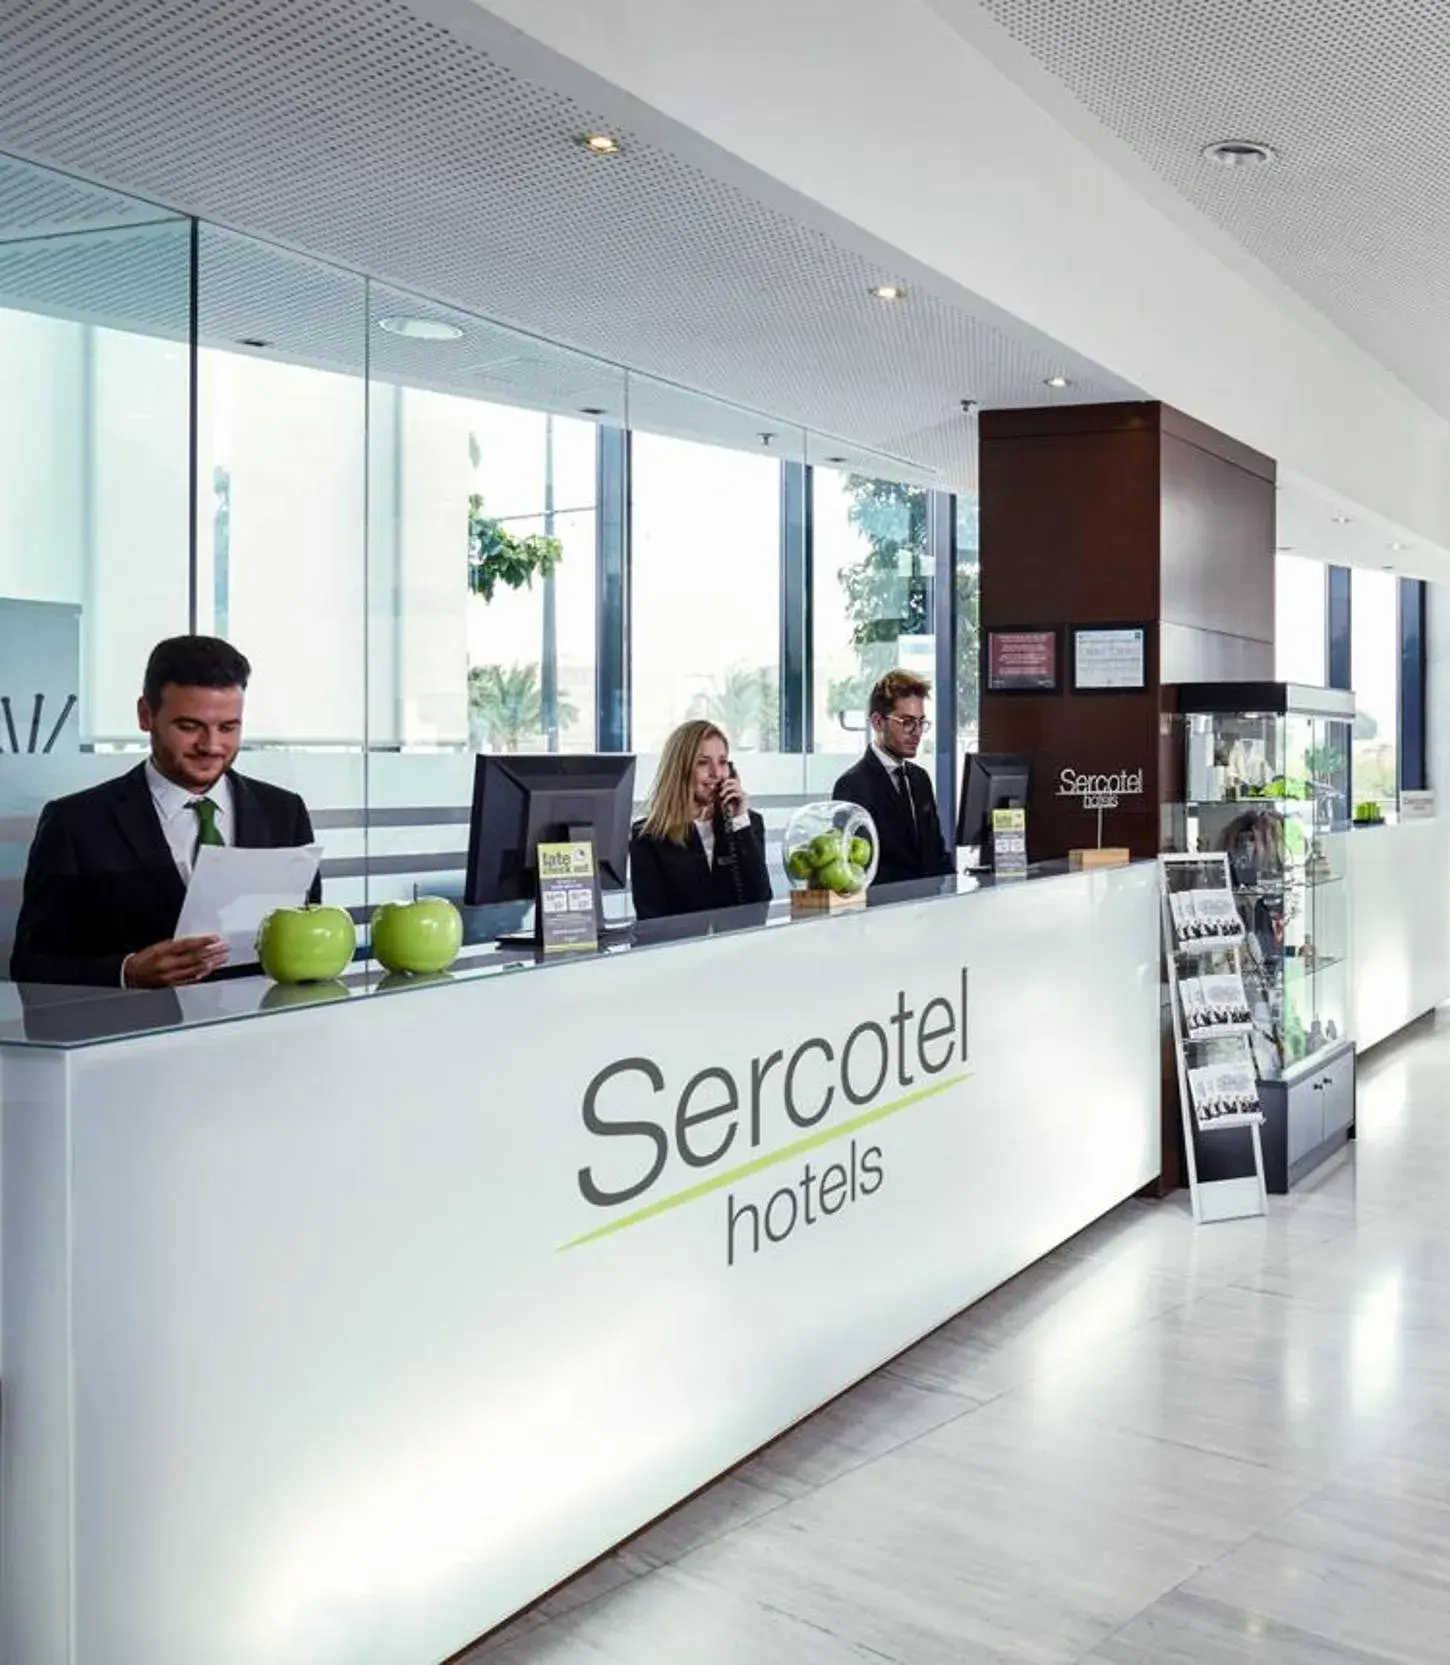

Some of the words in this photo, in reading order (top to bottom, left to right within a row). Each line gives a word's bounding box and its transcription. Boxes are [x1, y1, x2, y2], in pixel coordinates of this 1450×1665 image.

[1060, 768, 1144, 793] Sercotel
[1083, 794, 1119, 809] hotels
[578, 966, 968, 1207] Sercotel
[727, 1139, 883, 1266] hotels
